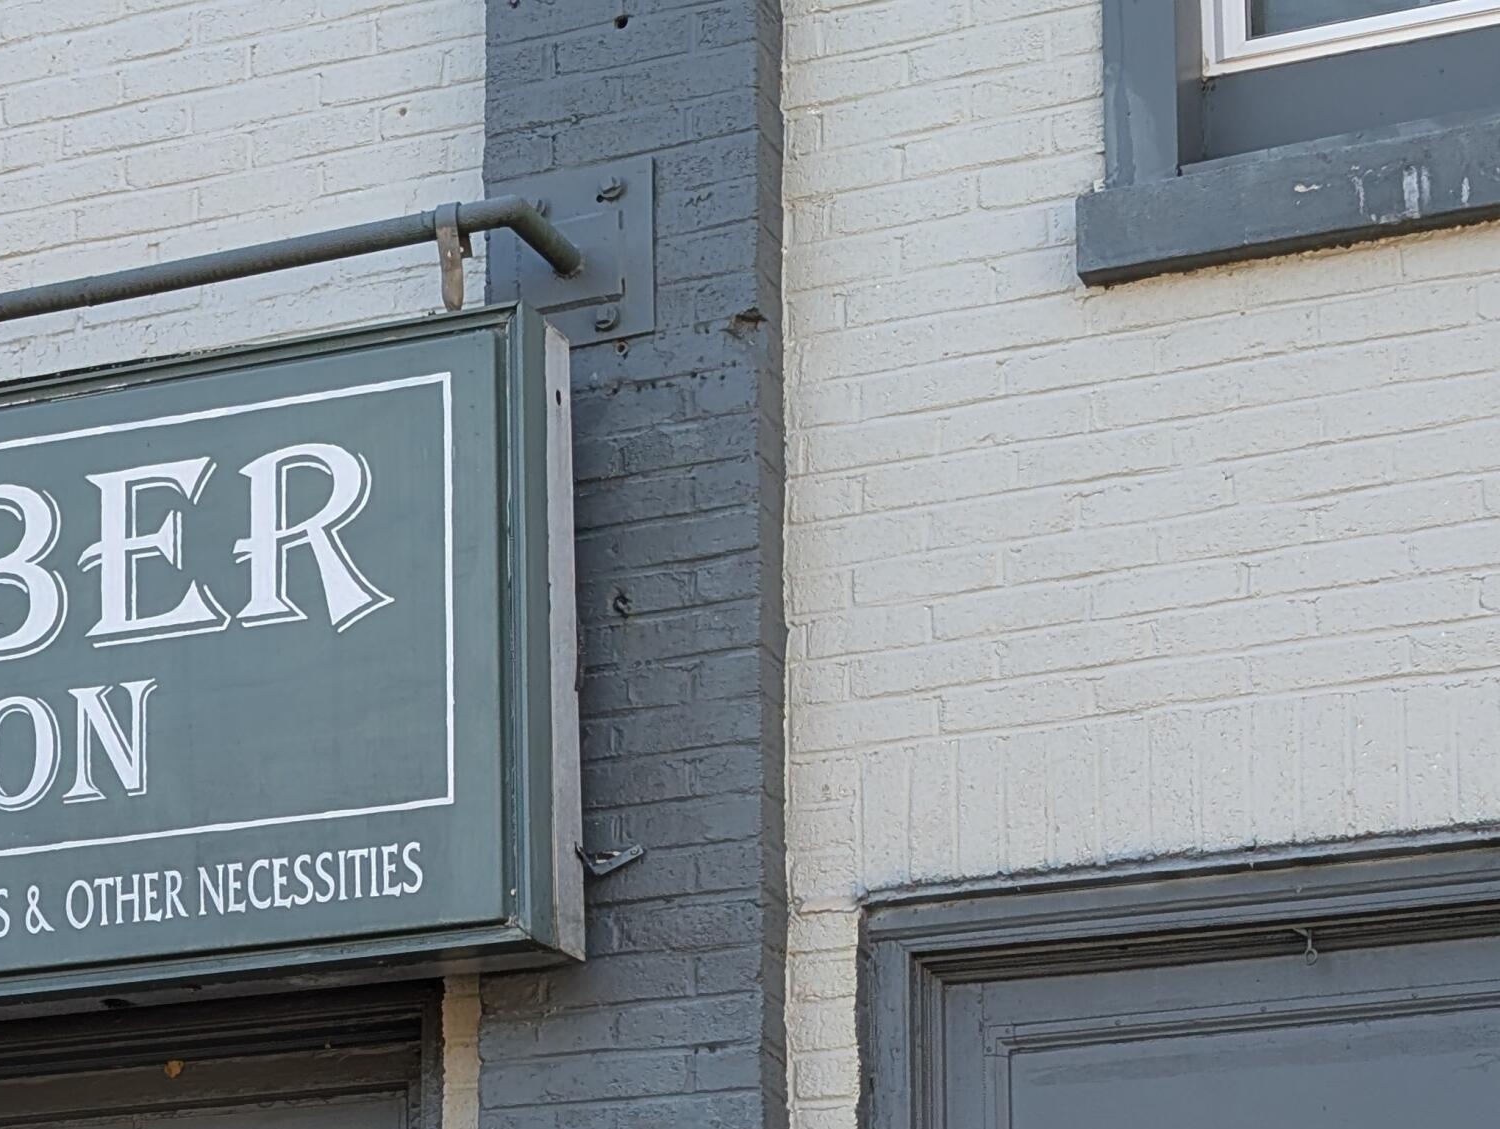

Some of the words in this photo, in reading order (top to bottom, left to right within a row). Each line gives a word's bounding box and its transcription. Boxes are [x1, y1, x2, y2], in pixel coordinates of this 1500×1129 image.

[25, 885, 55, 934] &
[66, 869, 189, 930] OTHER
[198, 841, 423, 917] NECESSITIES
